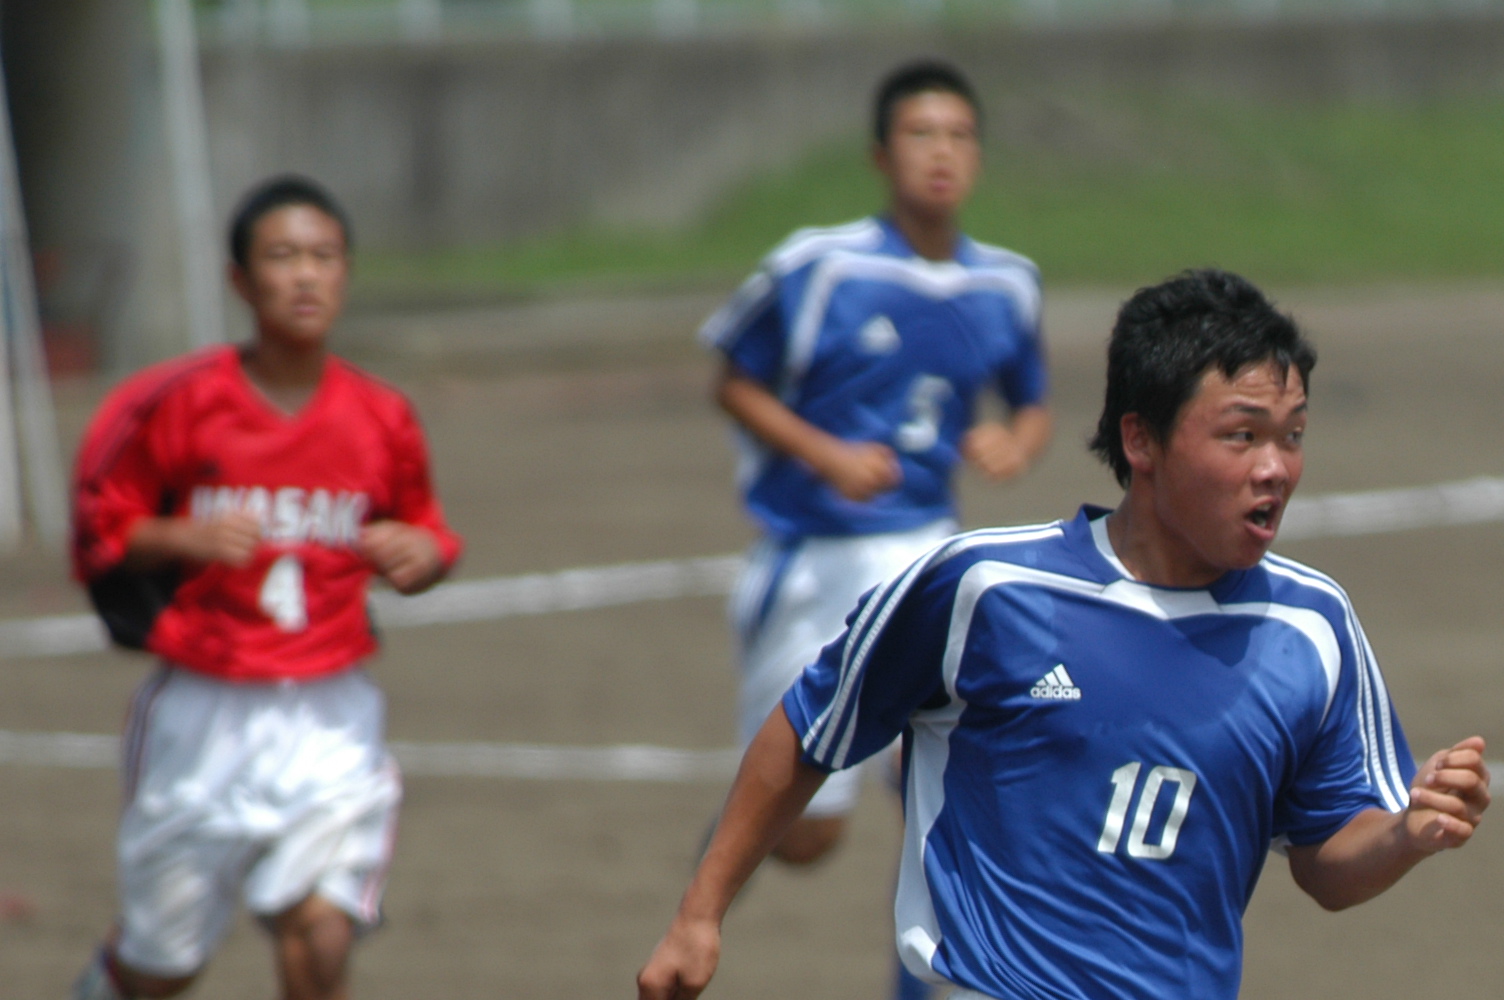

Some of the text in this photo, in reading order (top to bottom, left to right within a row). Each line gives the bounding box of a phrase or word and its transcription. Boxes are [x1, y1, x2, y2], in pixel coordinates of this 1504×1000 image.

[257, 551, 309, 633] 4
[1030, 685, 1081, 699] adidas
[1097, 761, 1197, 859] 10
